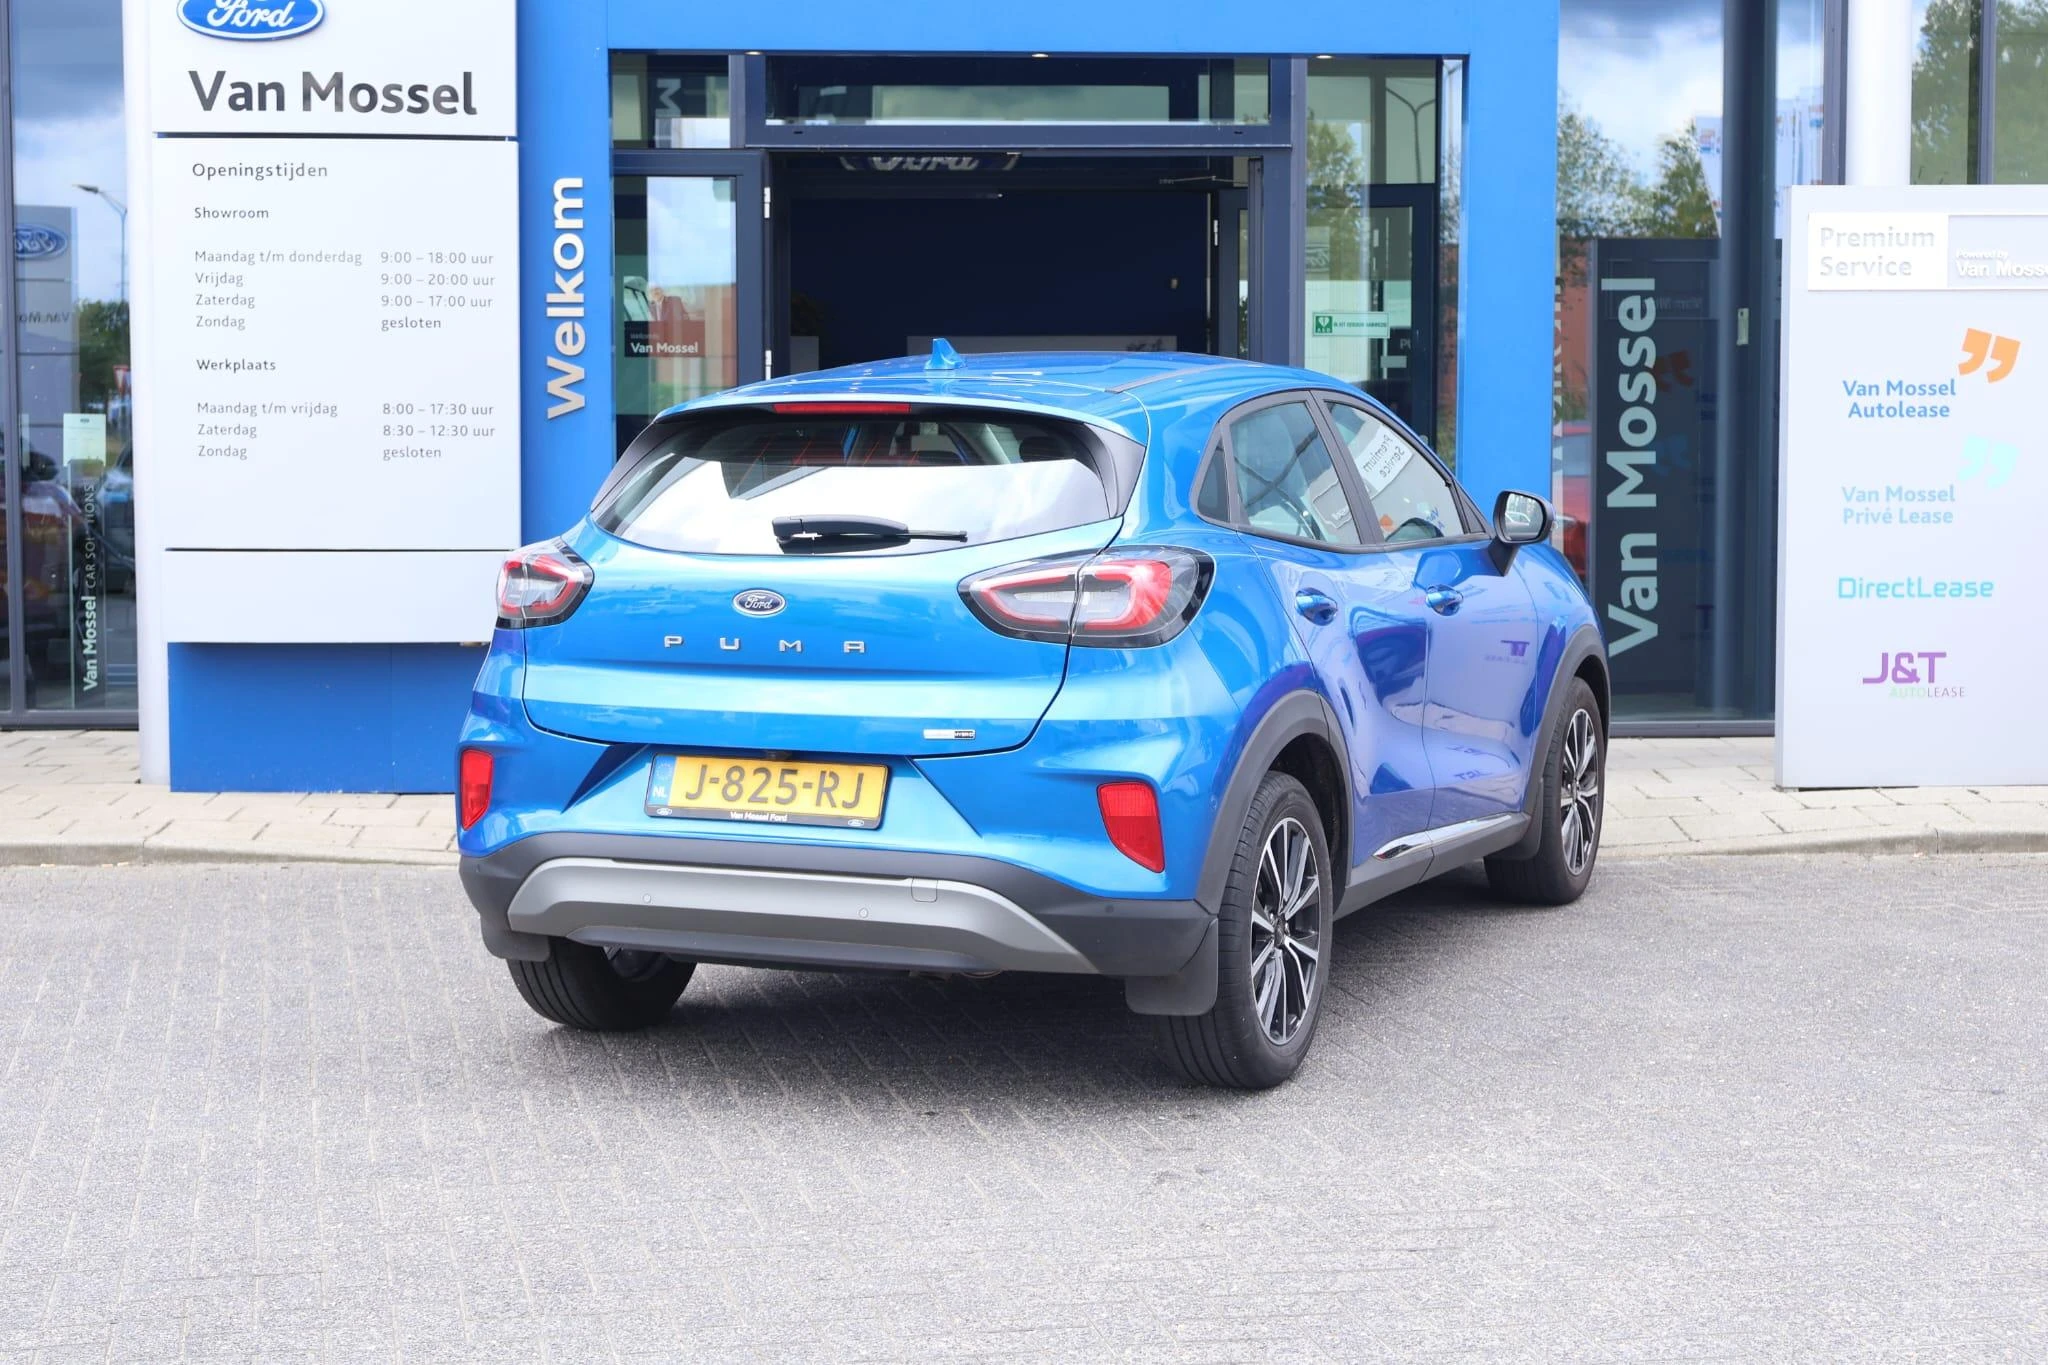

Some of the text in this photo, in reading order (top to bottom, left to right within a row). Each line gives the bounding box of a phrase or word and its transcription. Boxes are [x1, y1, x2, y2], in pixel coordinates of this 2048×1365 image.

[207, 0, 295, 27] Ford
[188, 71, 477, 115] Van Mossel
[192, 163, 328, 181] Openingstijden
[194, 207, 269, 219] Showroom
[1820, 226, 1934, 248] Premium
[194, 251, 256, 266] Maandag
[259, 250, 285, 264] t/m
[289, 250, 363, 267] donderdag
[380, 252, 412, 265] 9:00
[428, 252, 467, 265] 18:00
[471, 256, 494, 265] uur
[1820, 256, 1912, 277] Service
[1956, 260, 1989, 277] Van
[194, 272, 244, 288] Vrijdag
[380, 273, 412, 286] 9:00
[428, 273, 468, 286] 20:00
[472, 277, 496, 286] uur
[195, 294, 255, 310] Zaterdag
[380, 295, 412, 308] 9:00
[428, 295, 466, 308] 17:00
[471, 299, 493, 308] uur
[546, 177, 586, 420] Welkom
[196, 315, 442, 332] Zondag gesloten
[630, 342, 699, 353] Van Mossel
[196, 359, 276, 374] Werkplaats
[1842, 379, 1957, 397] Van Mossel
[197, 402, 258, 417] Maandag
[261, 402, 287, 415] t/m
[291, 402, 338, 418] vrijdag
[382, 403, 414, 416] 8:00
[430, 403, 467, 416] 17:30
[472, 407, 494, 416] uur
[1848, 401, 1950, 418] Autolease
[197, 423, 257, 439] Zaterdag
[382, 424, 414, 437] 8:30
[430, 424, 469, 437] 12:30
[473, 428, 496, 437] uur
[198, 445, 442, 462] Zondag gesloten
[1601, 278, 1659, 658] Van Mossel
[1842, 485, 1956, 502] Van Mossel
[1843, 507, 1953, 524] Privé Lease
[85, 559, 96, 588] CAR
[1838, 576, 1994, 599] DirectLease
[745, 595, 773, 609] Ford
[81, 596, 97, 648] Mossel
[664, 635, 865, 653] PUMA
[83, 658, 98, 691] Van
[1862, 652, 1947, 684] J&T
[1889, 687, 1966, 698] AUTOLEASE
[653, 787, 668, 797] NL
[685, 764, 864, 809] J-825-RJ
[730, 811, 743, 819] Van
[770, 814, 787, 822] Ford
